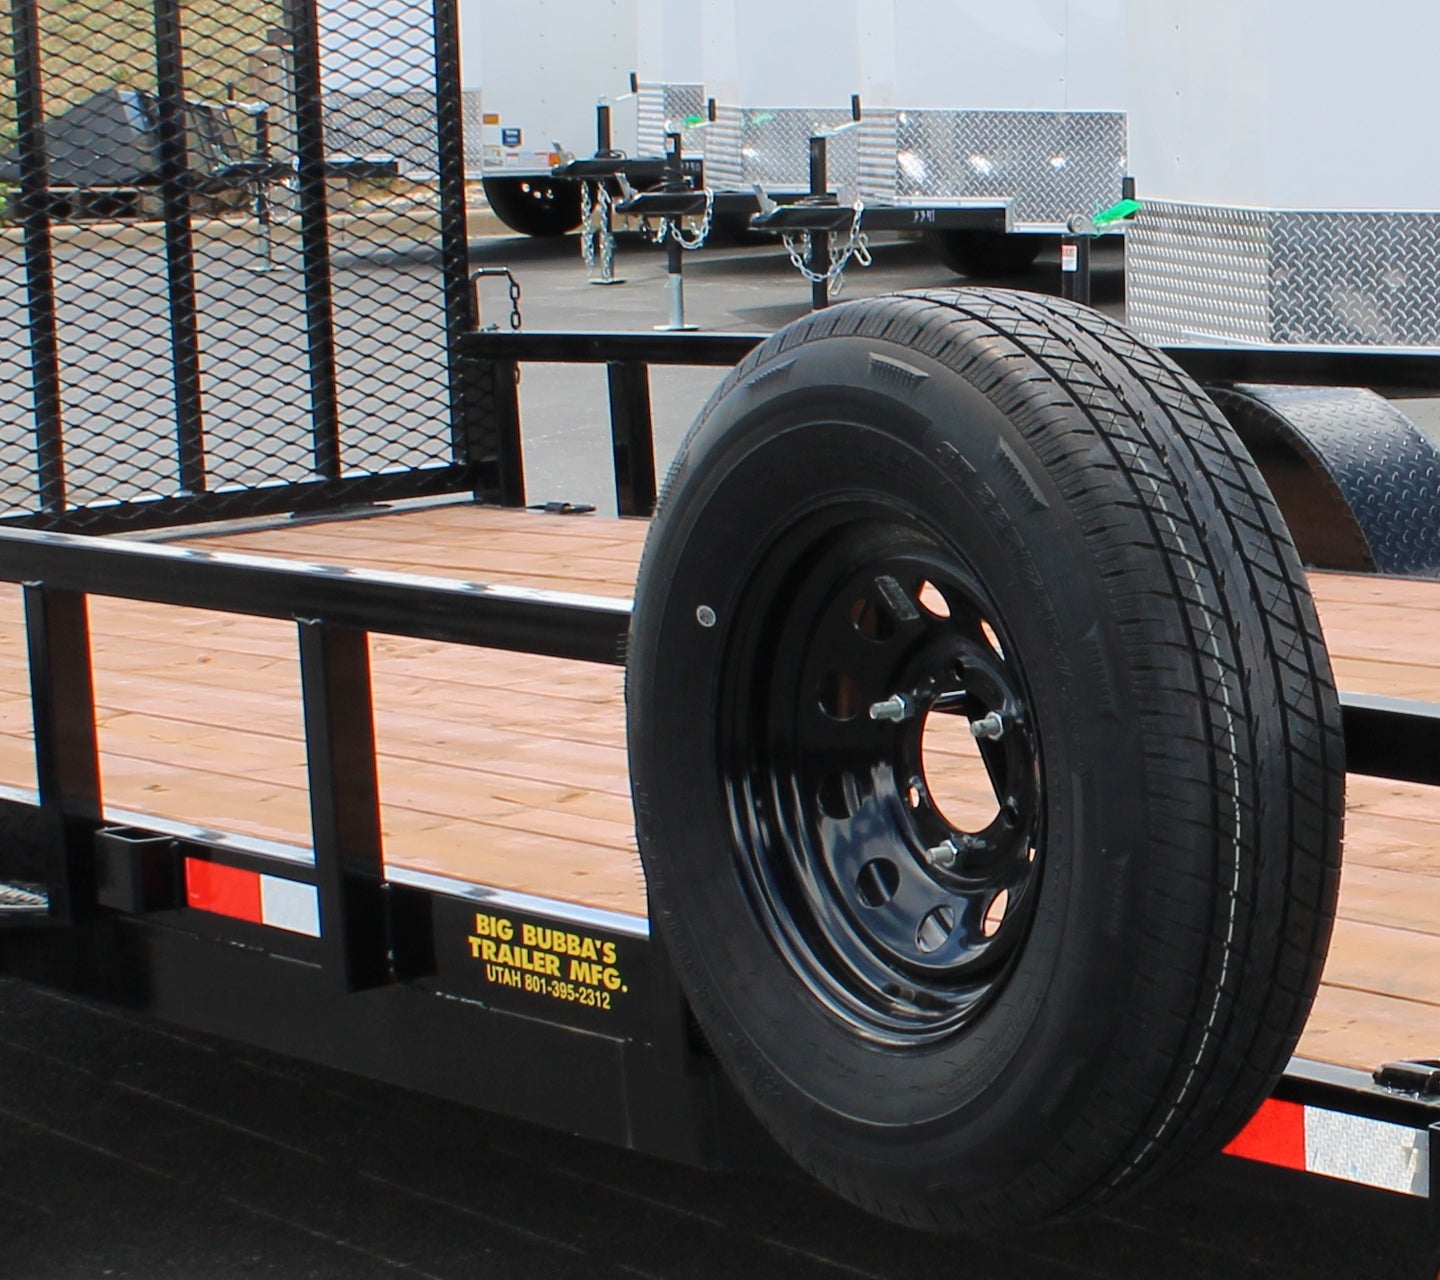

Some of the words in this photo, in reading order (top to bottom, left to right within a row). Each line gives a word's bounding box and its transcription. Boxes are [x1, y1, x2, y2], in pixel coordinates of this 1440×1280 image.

[476, 913, 513, 941] BIG
[521, 923, 617, 964] BUBBA'S
[468, 936, 561, 977] TRAILER
[570, 959, 628, 993] MFG.
[486, 964, 522, 988] UTAH
[524, 973, 611, 1010] 801-395-2312
